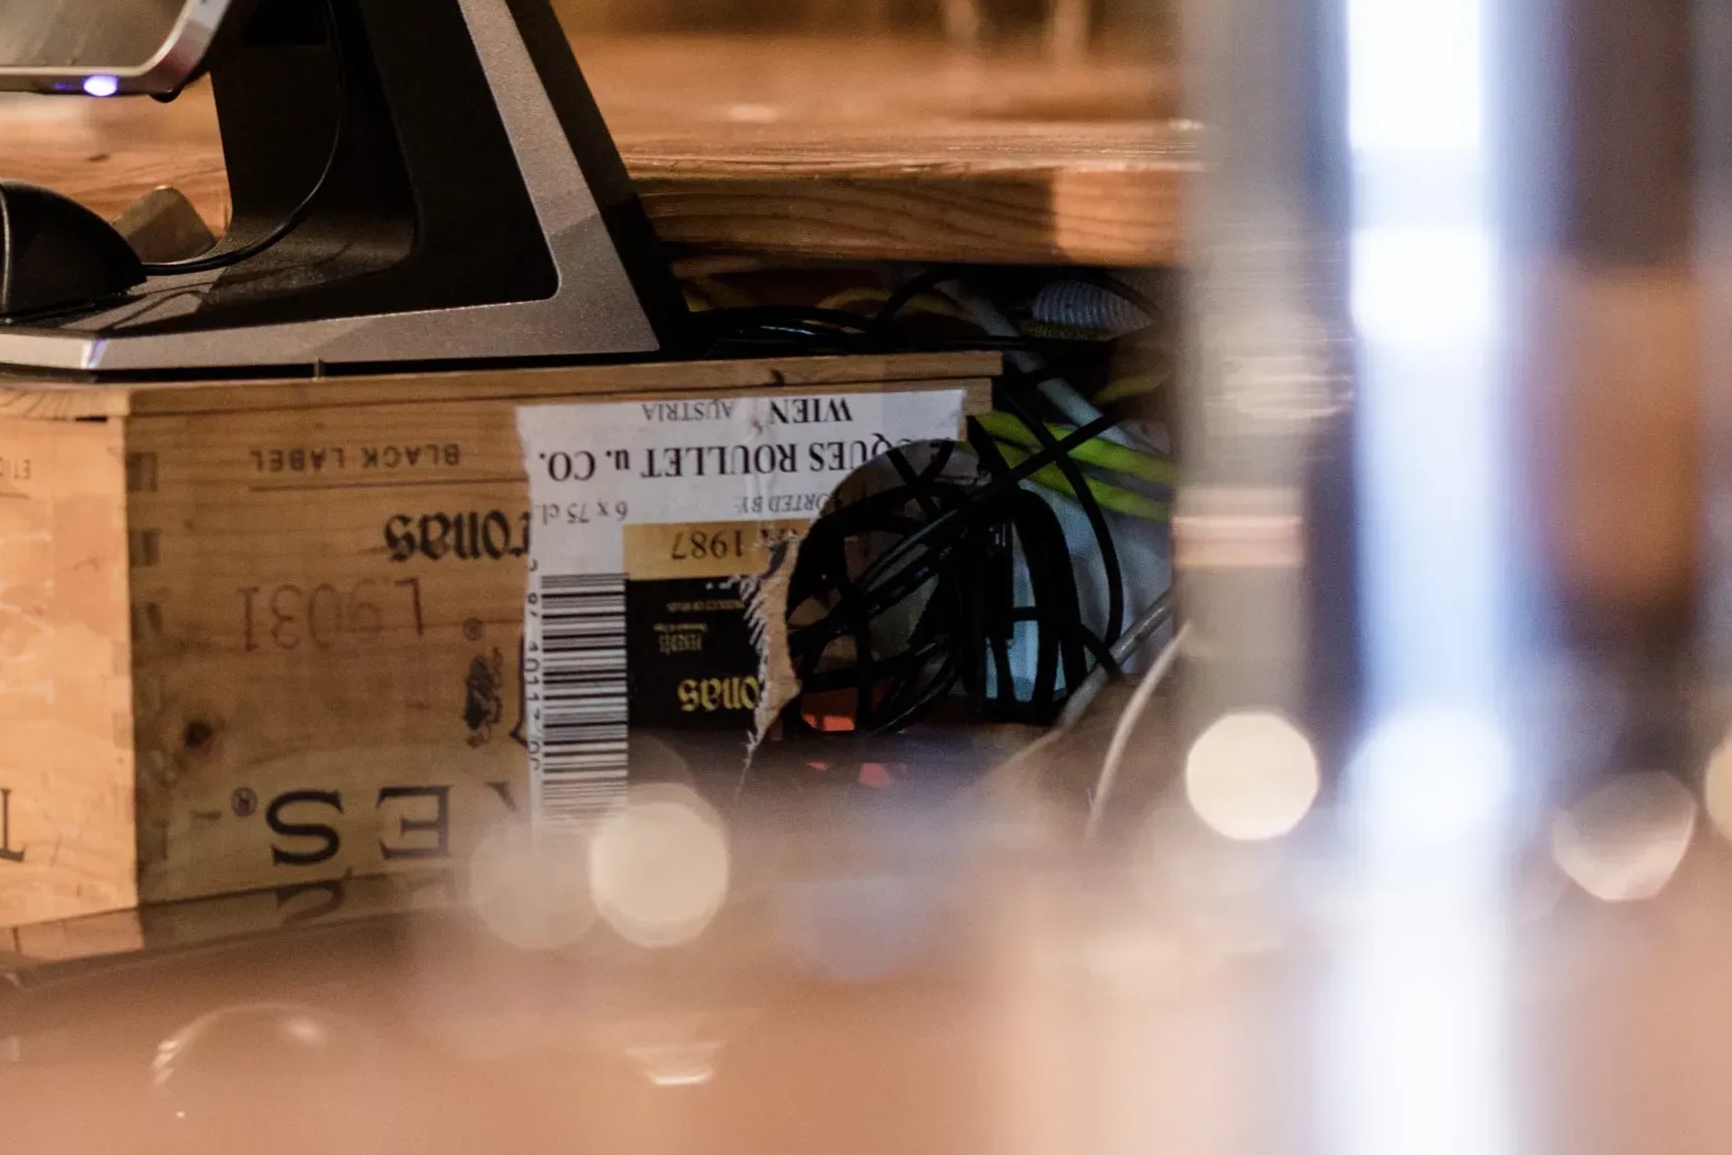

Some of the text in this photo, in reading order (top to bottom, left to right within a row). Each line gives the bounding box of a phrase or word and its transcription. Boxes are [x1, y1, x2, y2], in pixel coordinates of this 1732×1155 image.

[641, 397, 853, 424] WIEN AUSTRIA
[248, 443, 460, 472] BLACK LABEL
[539, 450, 596, 482] CO.
[639, 443, 798, 479] ROULLET
[808, 433, 914, 471] QUES
[567, 503, 590, 525] 75
[614, 500, 628, 522] 6
[670, 529, 744, 561] 1987
